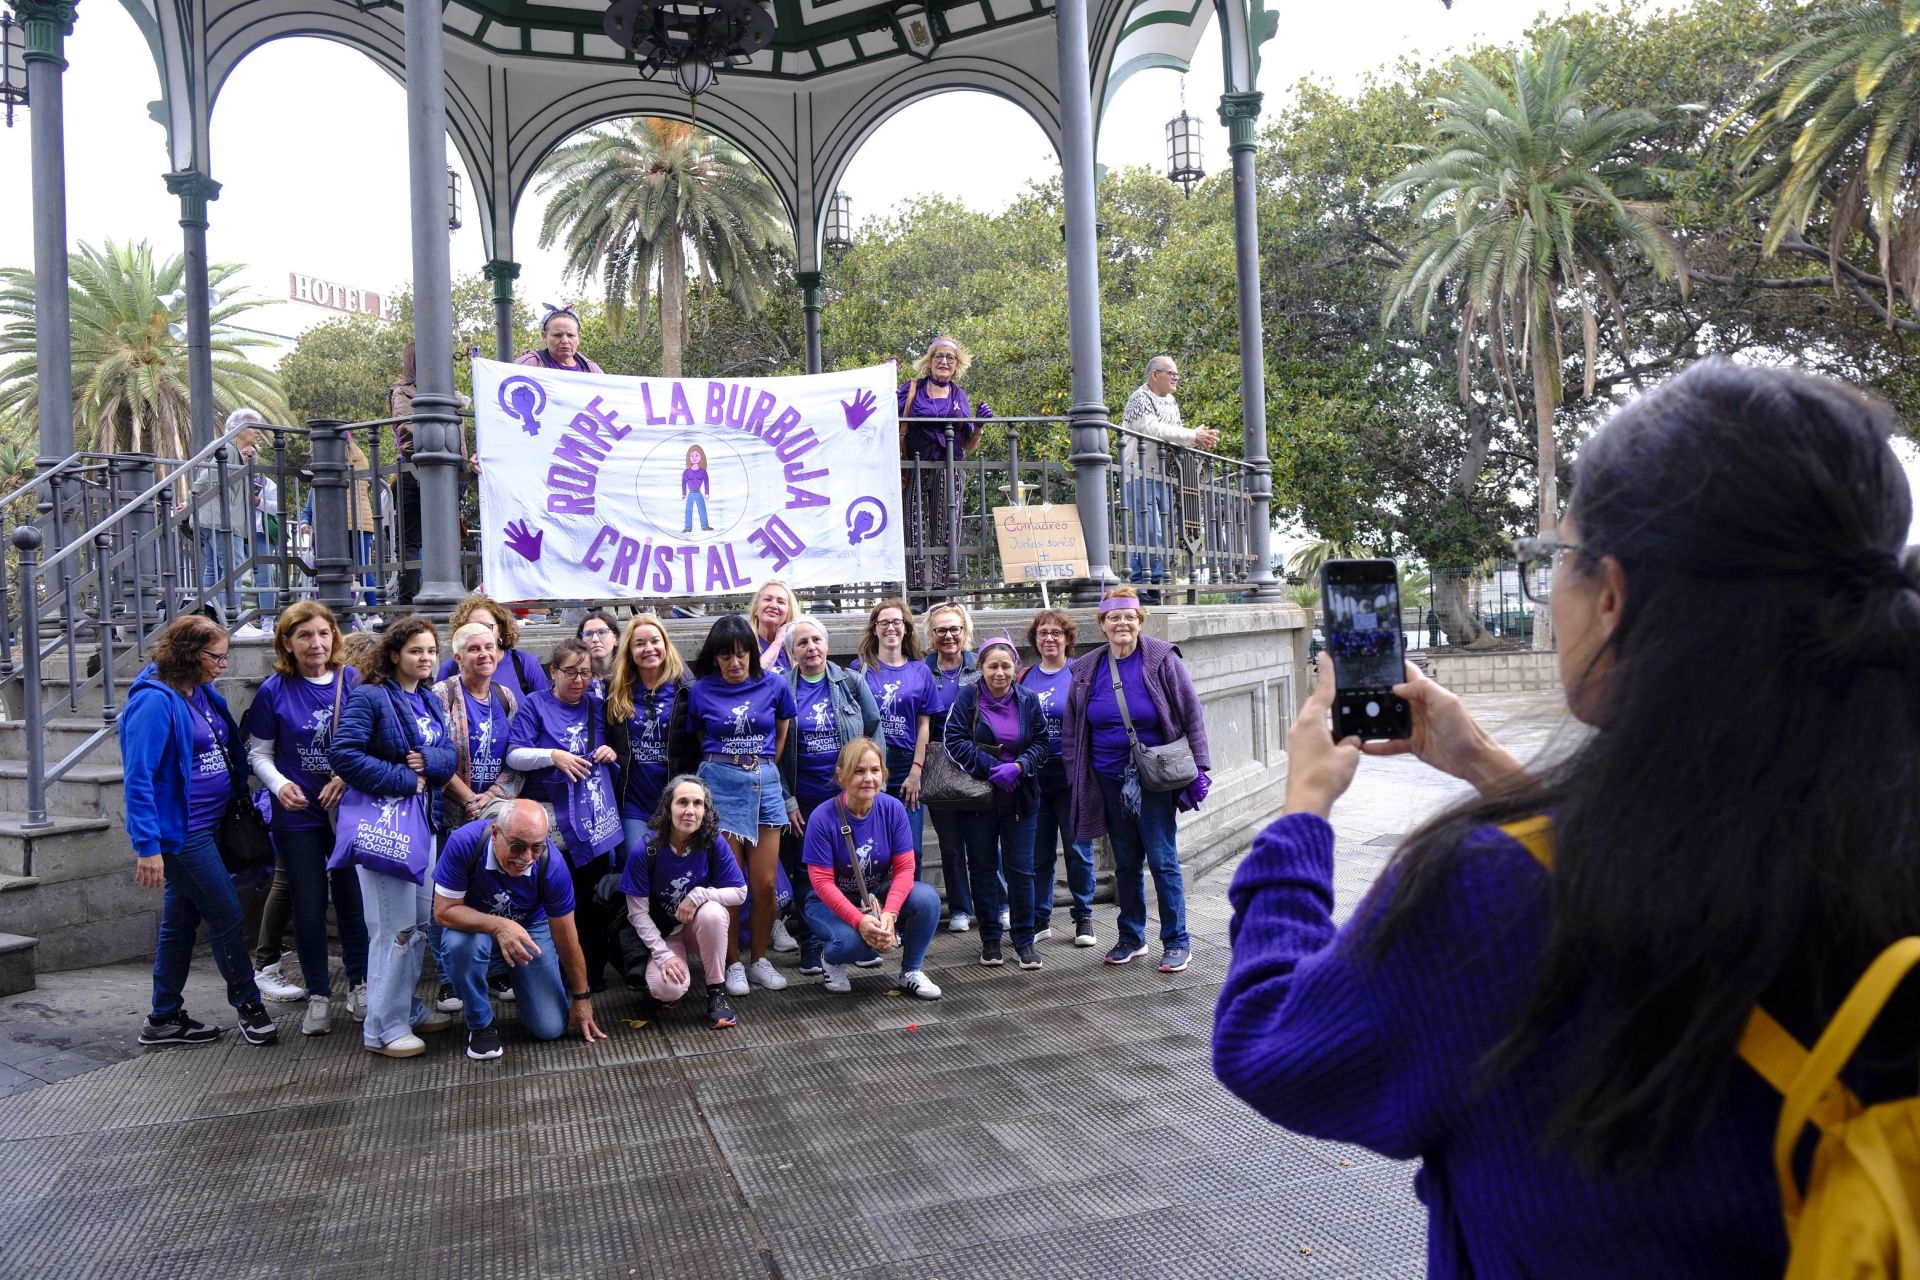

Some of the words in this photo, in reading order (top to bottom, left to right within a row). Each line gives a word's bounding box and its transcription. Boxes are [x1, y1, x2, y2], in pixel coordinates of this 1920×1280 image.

[294, 273, 371, 313] HOTEL
[641, 382, 694, 425] LA
[547, 395, 632, 516] ROMPE
[705, 381, 830, 510] BURBUJA
[747, 514, 806, 573] DE
[722, 746, 762, 754] PROGRESO
[807, 743, 841, 752] PROGRES
[808, 738, 834, 746] MOTOR
[357, 823, 410, 844] IGUALDAD
[357, 831, 394, 847] MOTOR
[394, 840, 411, 853] DEL
[353, 838, 407, 860] PROGRESO
